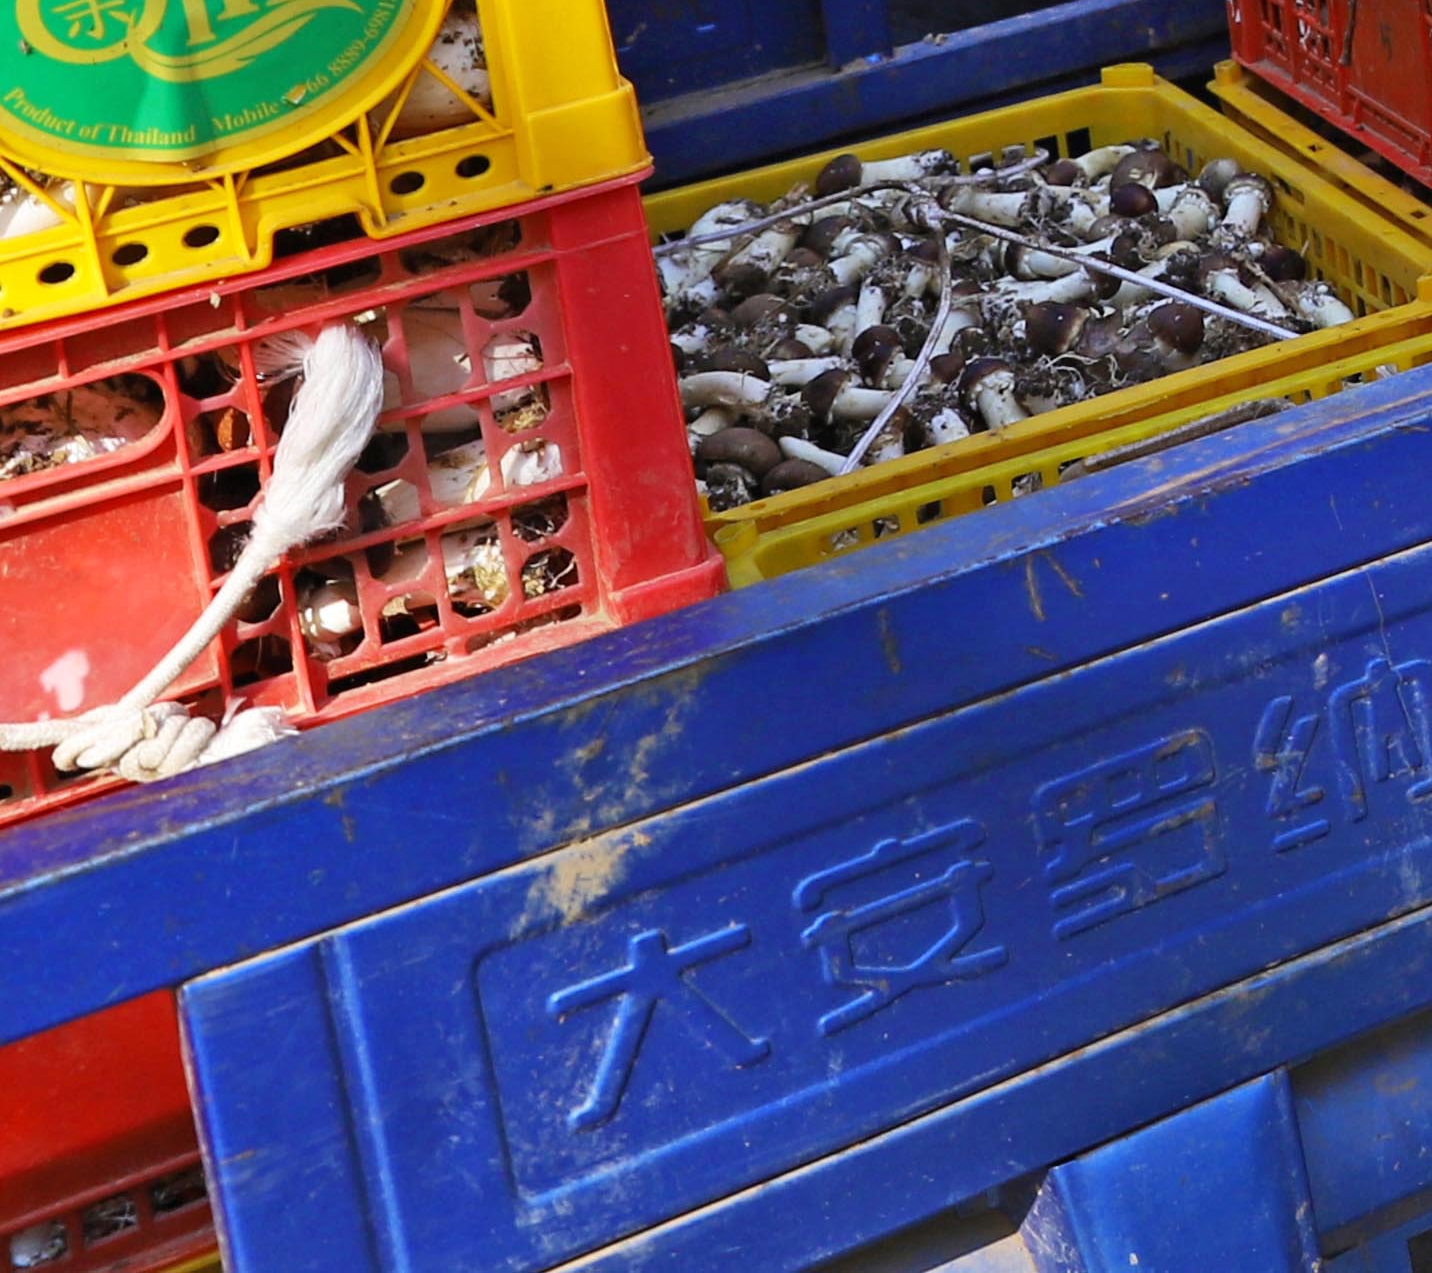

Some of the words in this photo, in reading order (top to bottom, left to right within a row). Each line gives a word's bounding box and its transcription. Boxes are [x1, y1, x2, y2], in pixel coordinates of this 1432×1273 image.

[4, 86, 76, 134] Product
[78, 123, 100, 140] of
[106, 123, 197, 145] Thailand
[211, 101, 281, 133] Mobile
